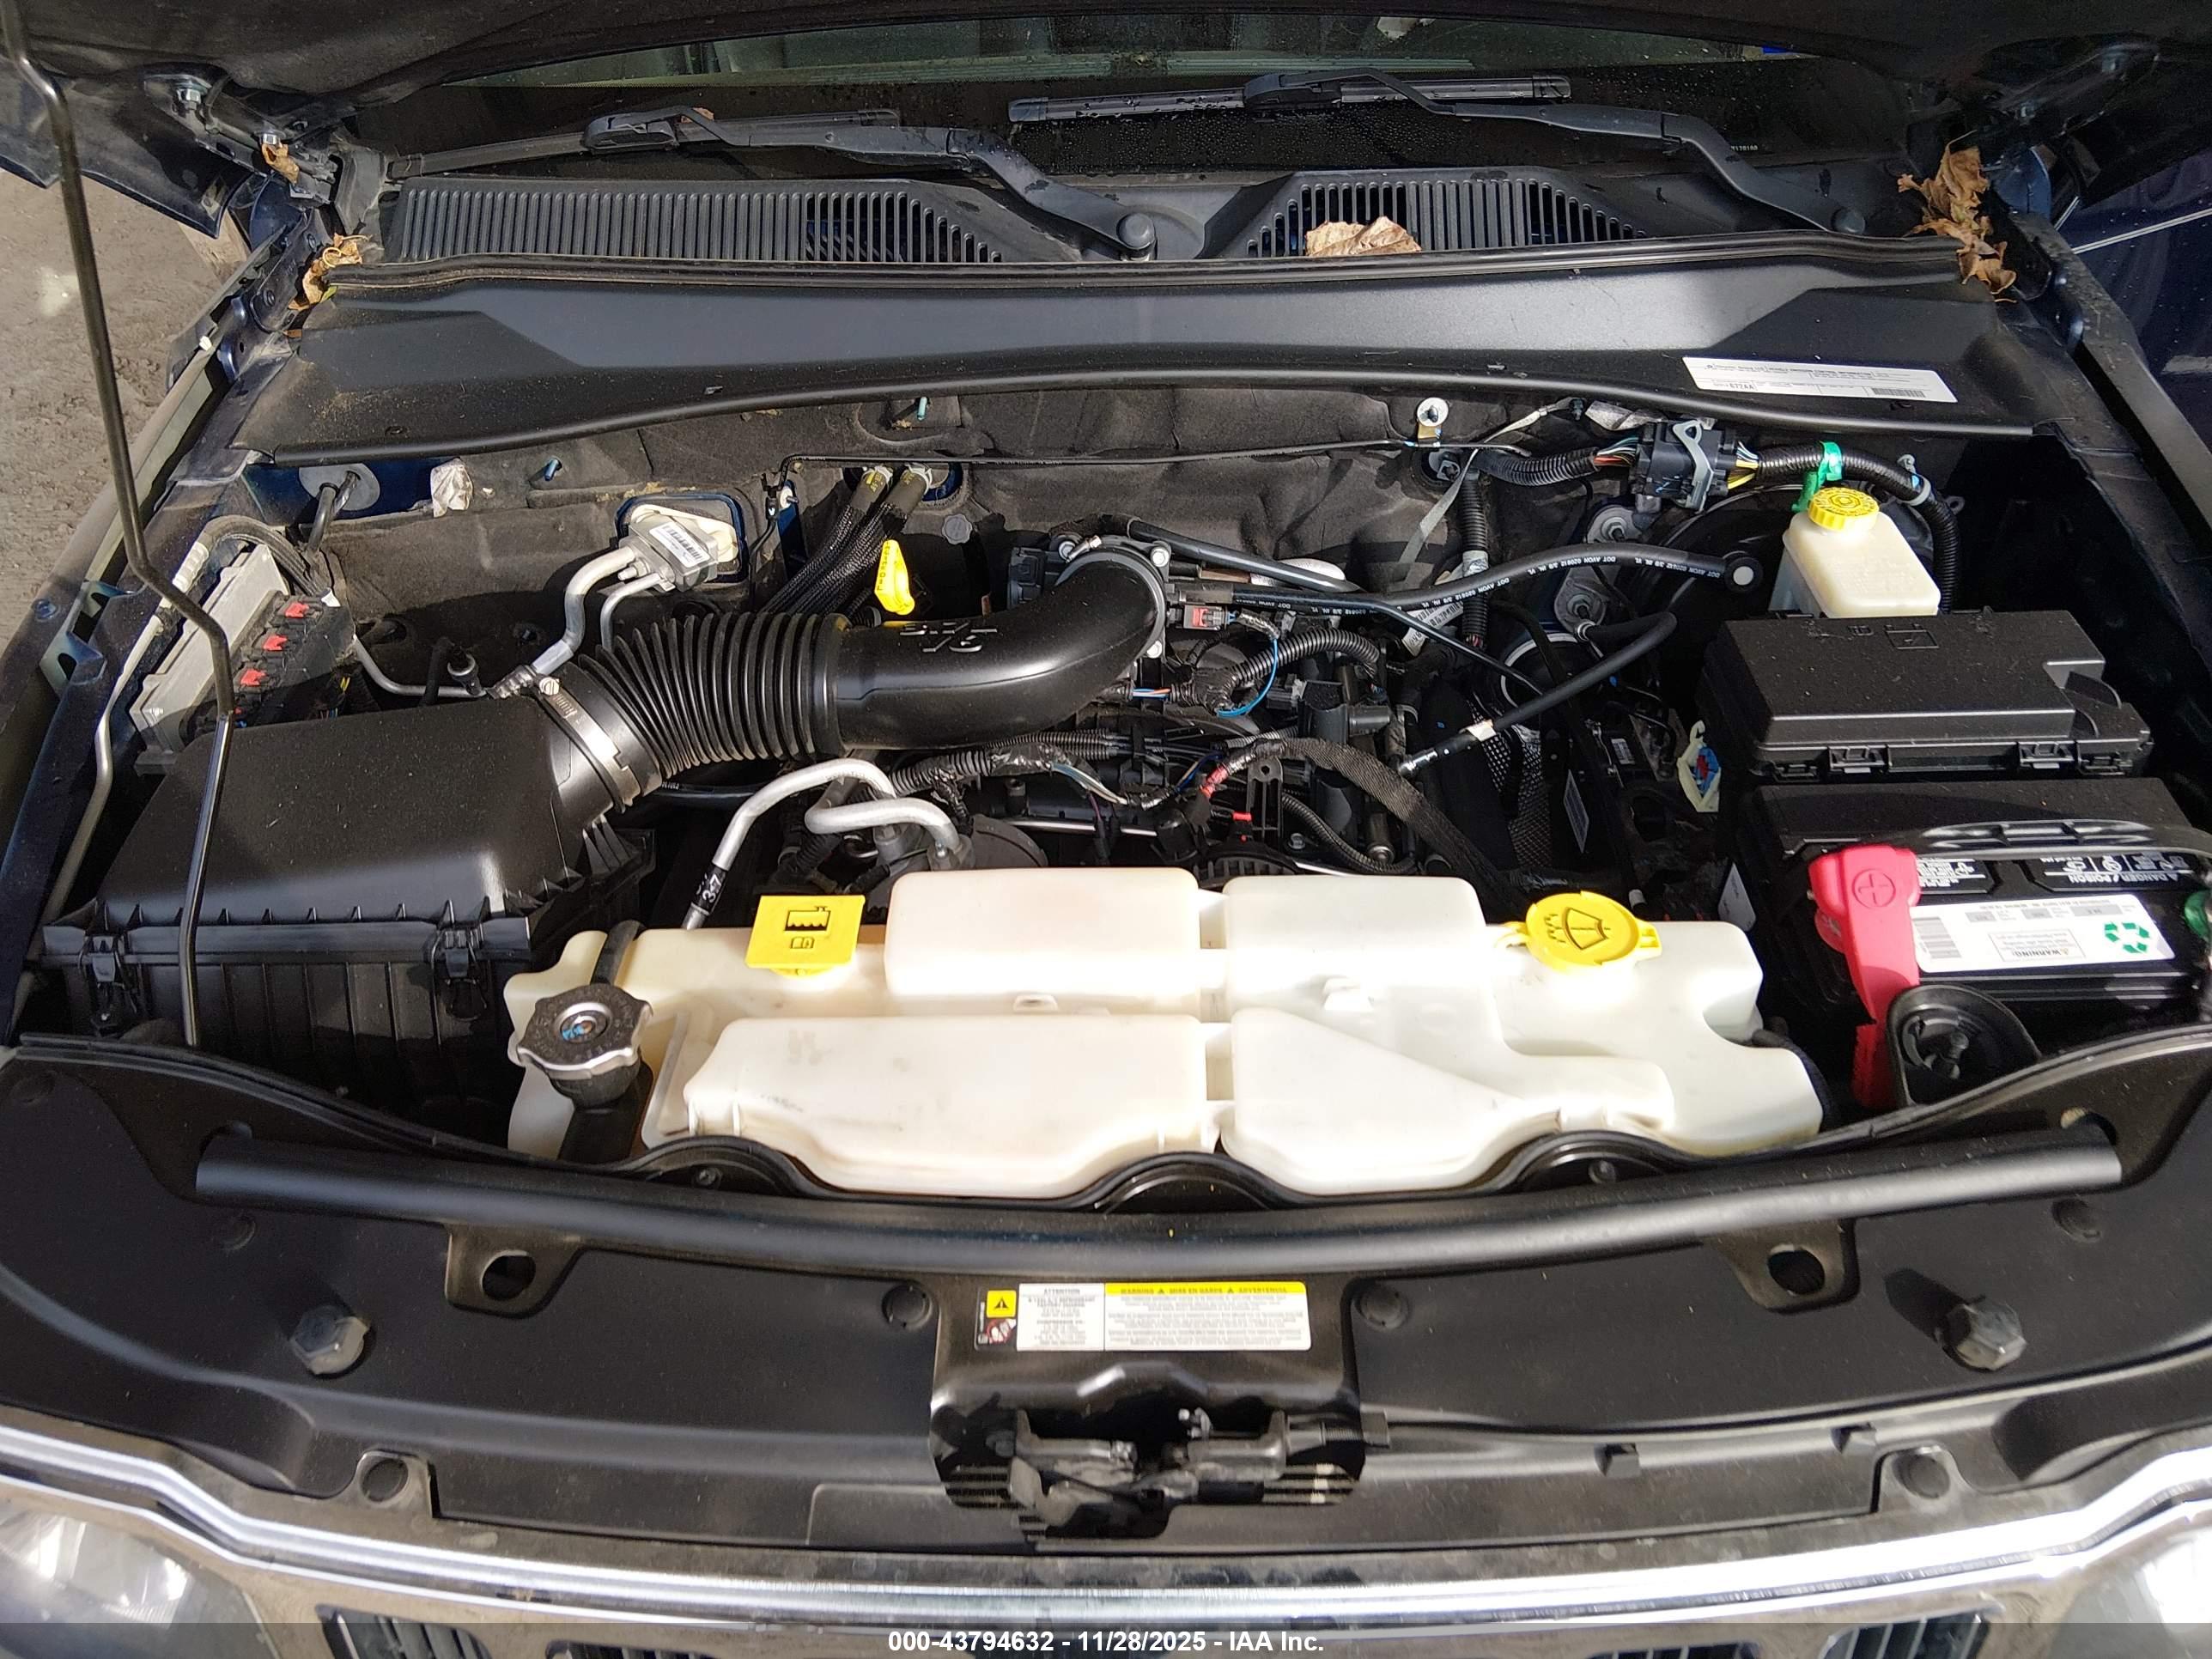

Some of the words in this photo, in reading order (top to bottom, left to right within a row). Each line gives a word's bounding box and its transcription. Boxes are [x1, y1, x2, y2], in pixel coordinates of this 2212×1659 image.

[1583, 556, 1601, 564] AVON
[1497, 577, 1510, 586] DOT
[1478, 582, 1495, 593] AVON
[2068, 872, 2112, 884] POISON
[2120, 872, 2169, 882] DANGER
